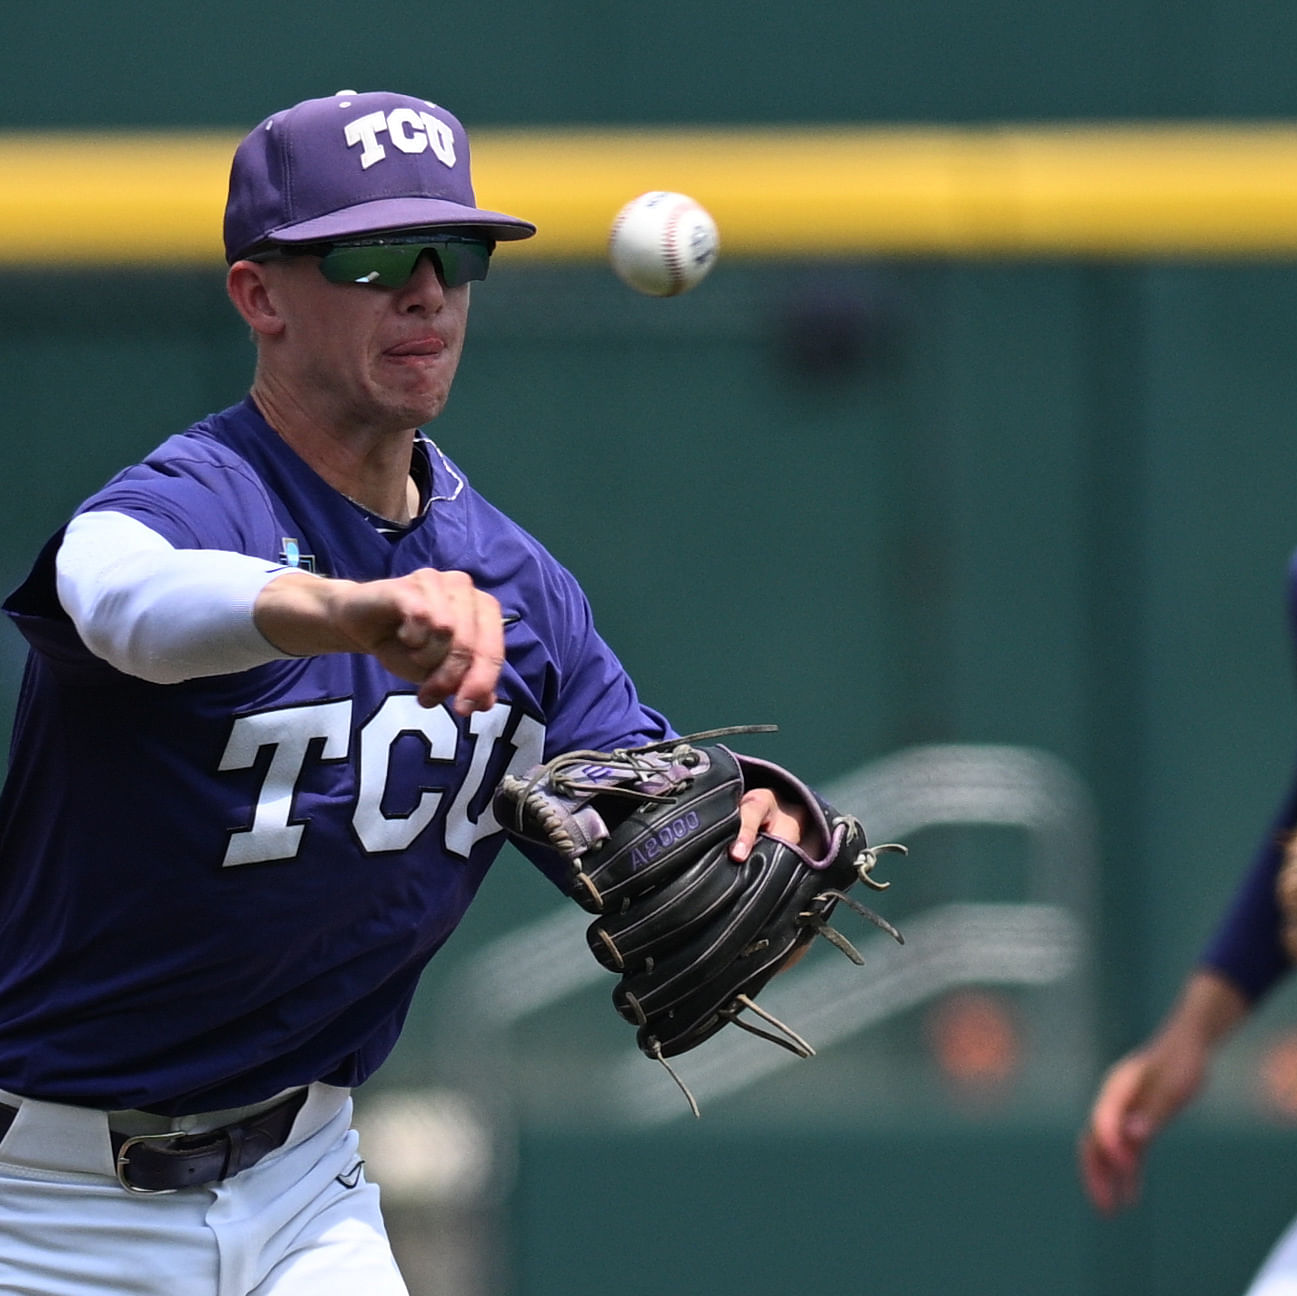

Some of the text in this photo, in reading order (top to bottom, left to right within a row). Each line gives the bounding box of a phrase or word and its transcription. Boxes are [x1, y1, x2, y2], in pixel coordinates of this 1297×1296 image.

[344, 108, 456, 171] TCU
[218, 694, 547, 868] TCU
[629, 810, 701, 872] A2000
